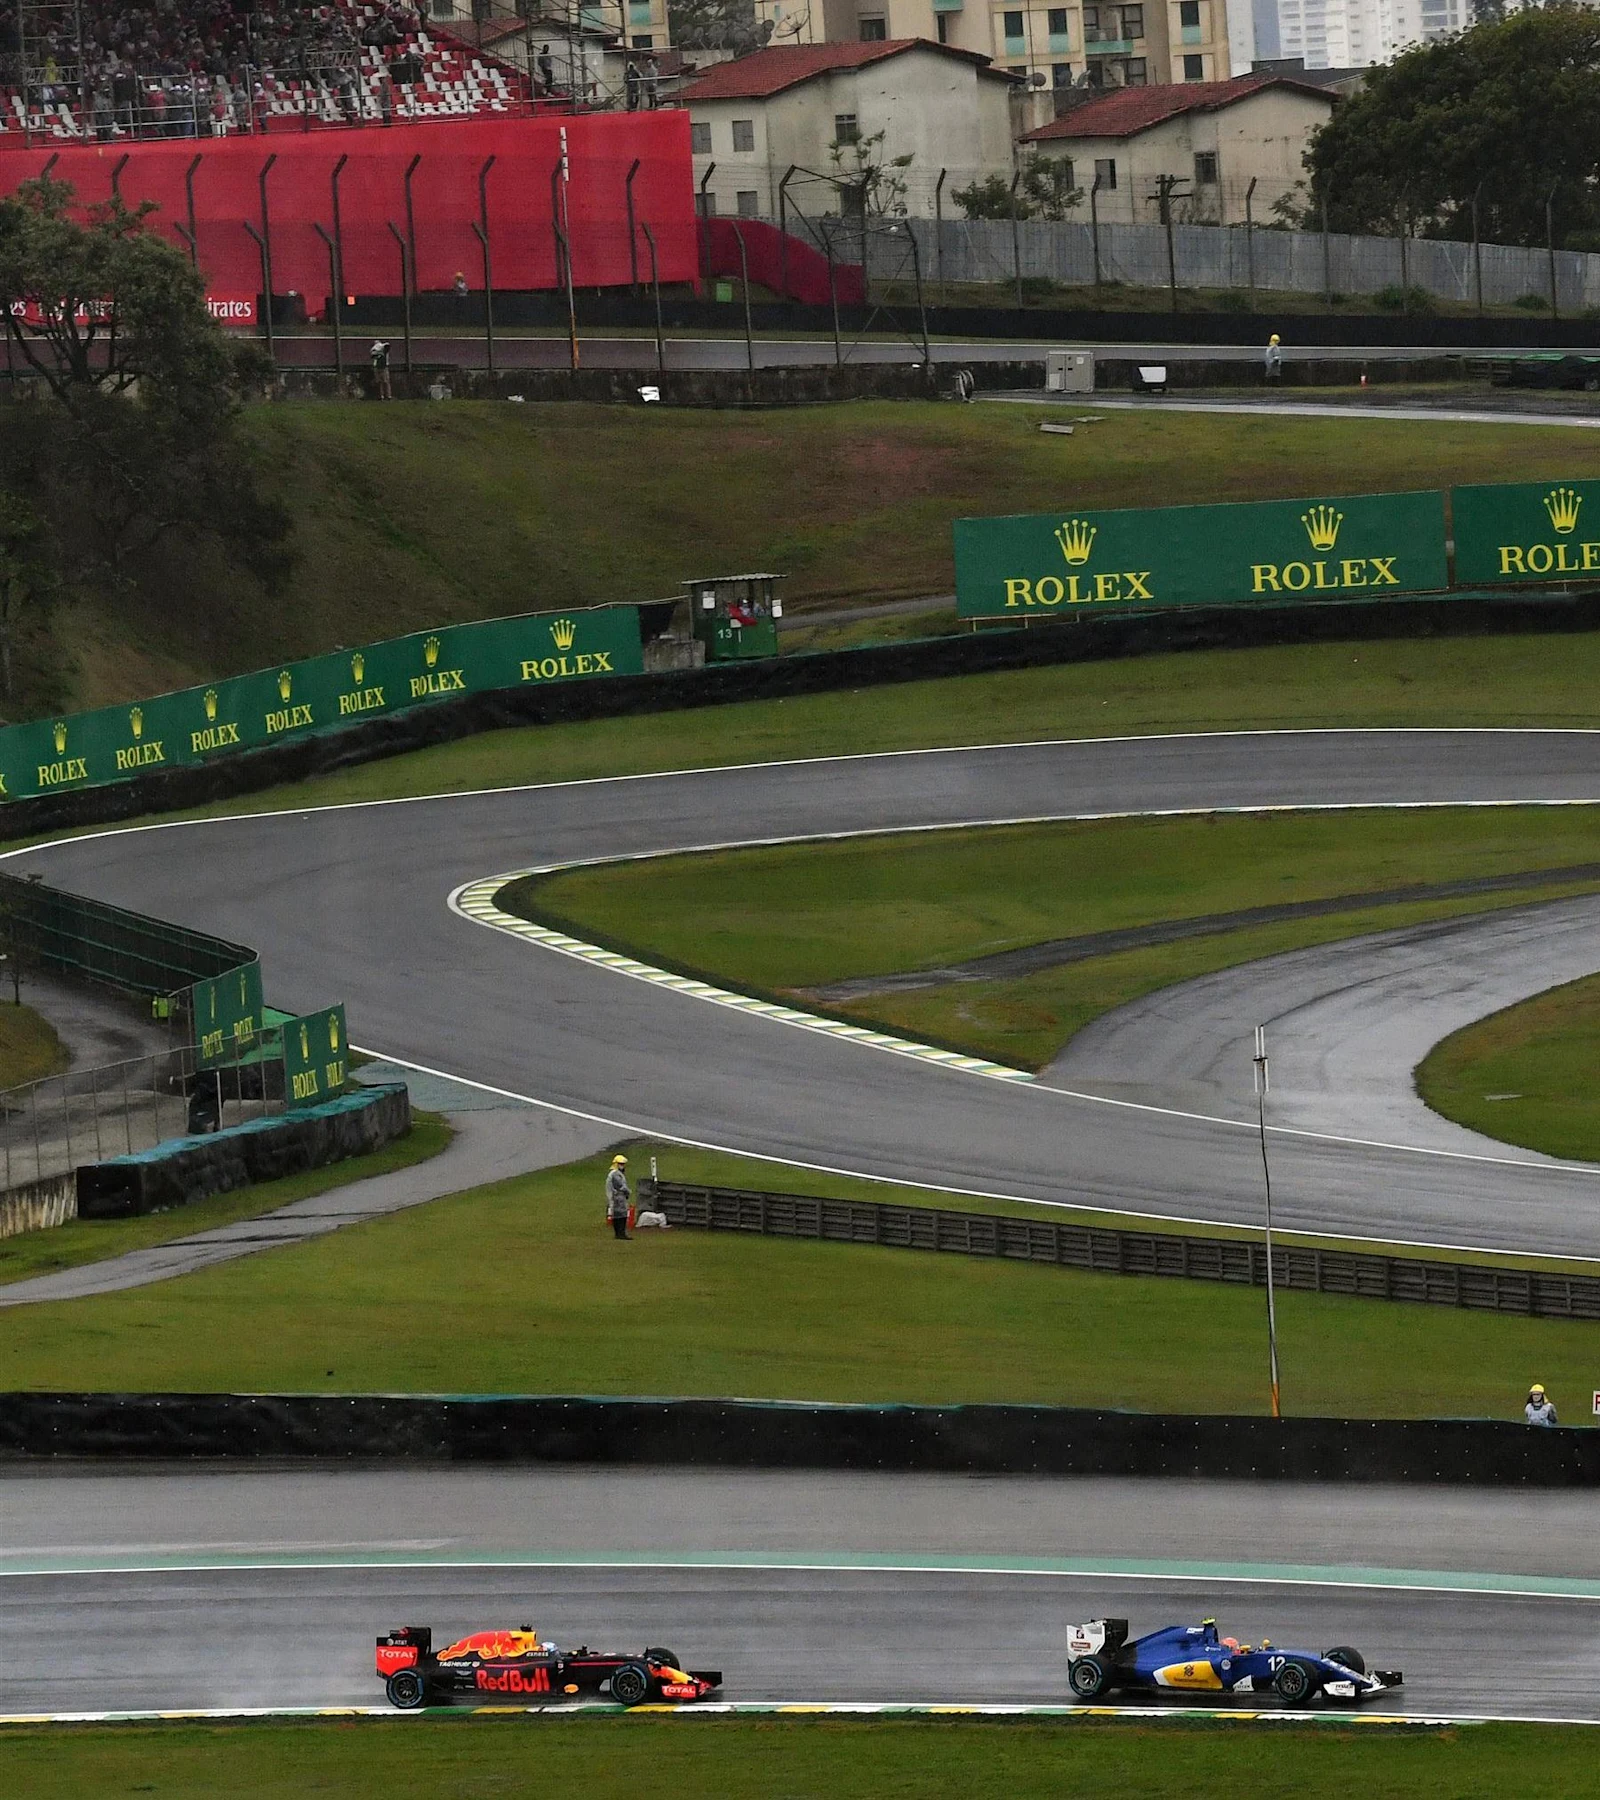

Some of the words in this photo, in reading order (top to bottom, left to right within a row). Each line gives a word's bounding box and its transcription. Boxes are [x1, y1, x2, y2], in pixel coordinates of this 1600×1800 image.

[206, 297, 252, 318] irates
[1003, 571, 1155, 608] ROLEX
[1250, 557, 1401, 593] ROLEX
[717, 628, 733, 639] 13
[520, 652, 614, 681] ROLEX
[410, 669, 466, 698] ROLEX
[338, 686, 385, 716] ROLEX
[264, 703, 315, 734] ROLEX
[190, 722, 241, 753] ROLEX
[115, 741, 166, 770] ROLEX
[37, 758, 88, 787] ROLEX
[292, 1069, 319, 1100] ROLEX
[379, 1648, 415, 1659] TOTAL
[1267, 1655, 1286, 1672] 12
[661, 1684, 697, 1695] TOTAL
